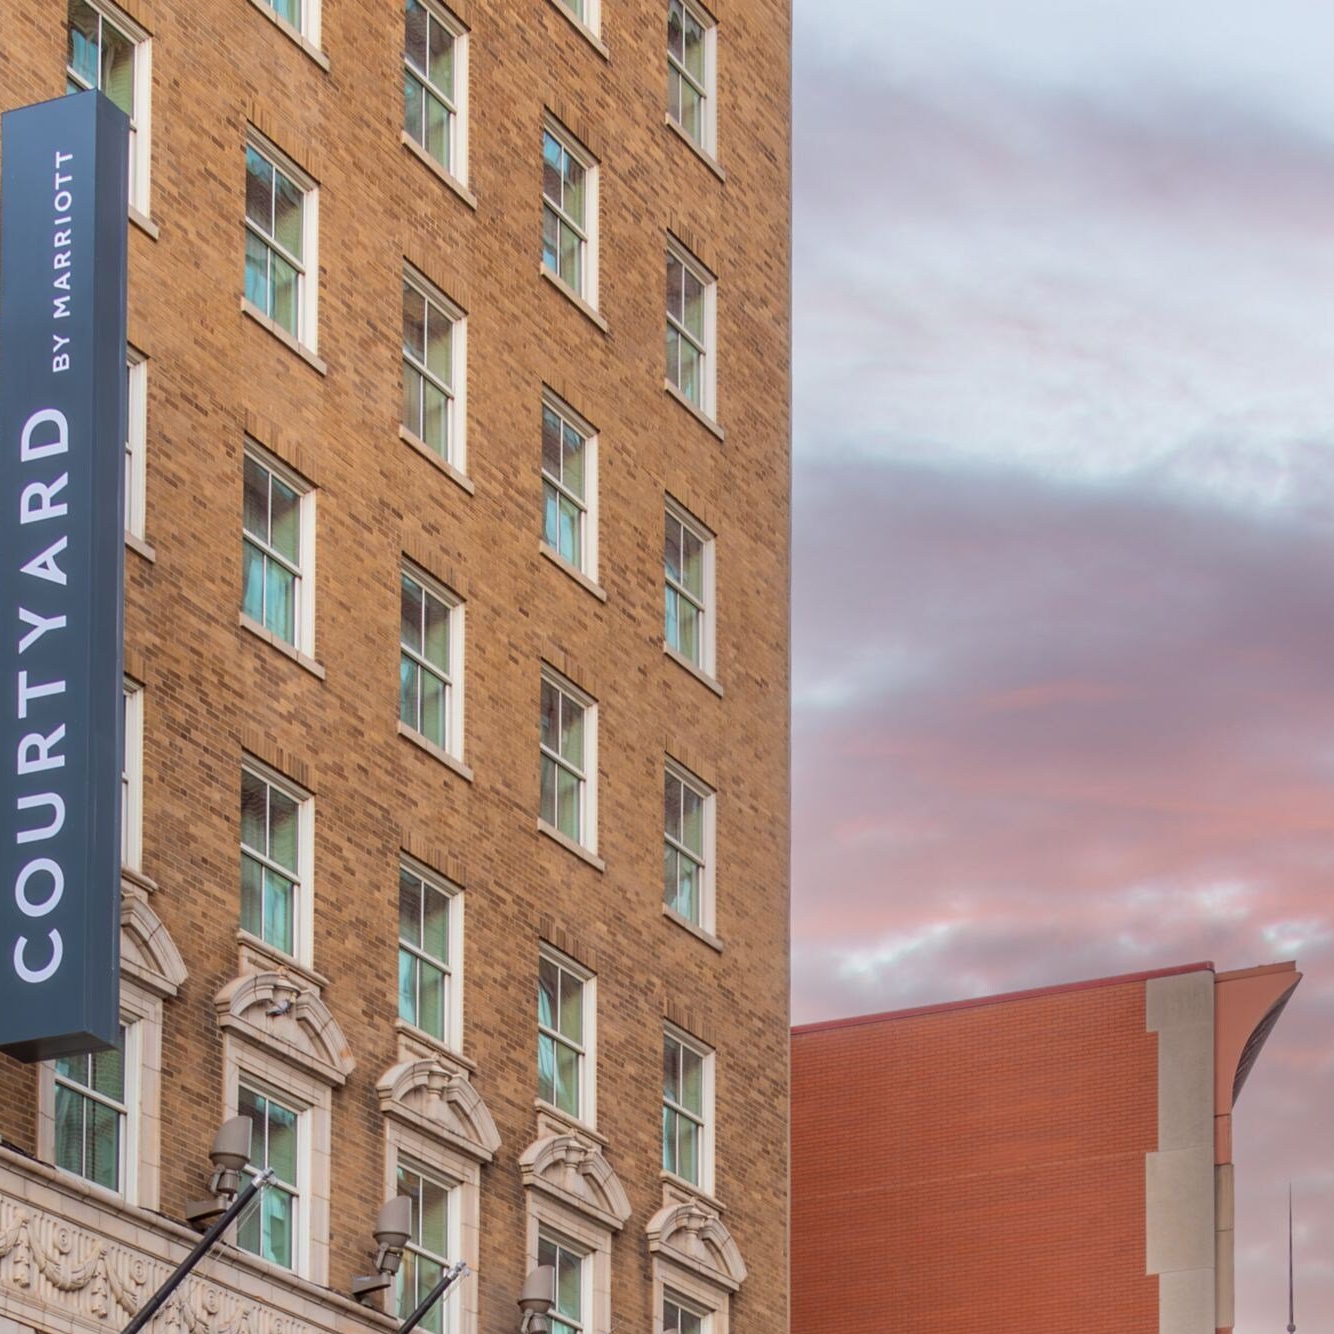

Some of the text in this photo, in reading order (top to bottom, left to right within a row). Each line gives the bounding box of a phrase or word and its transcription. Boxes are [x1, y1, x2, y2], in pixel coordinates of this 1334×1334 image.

[13, 151, 74, 984] COURTYARD BY MARRIOTT
